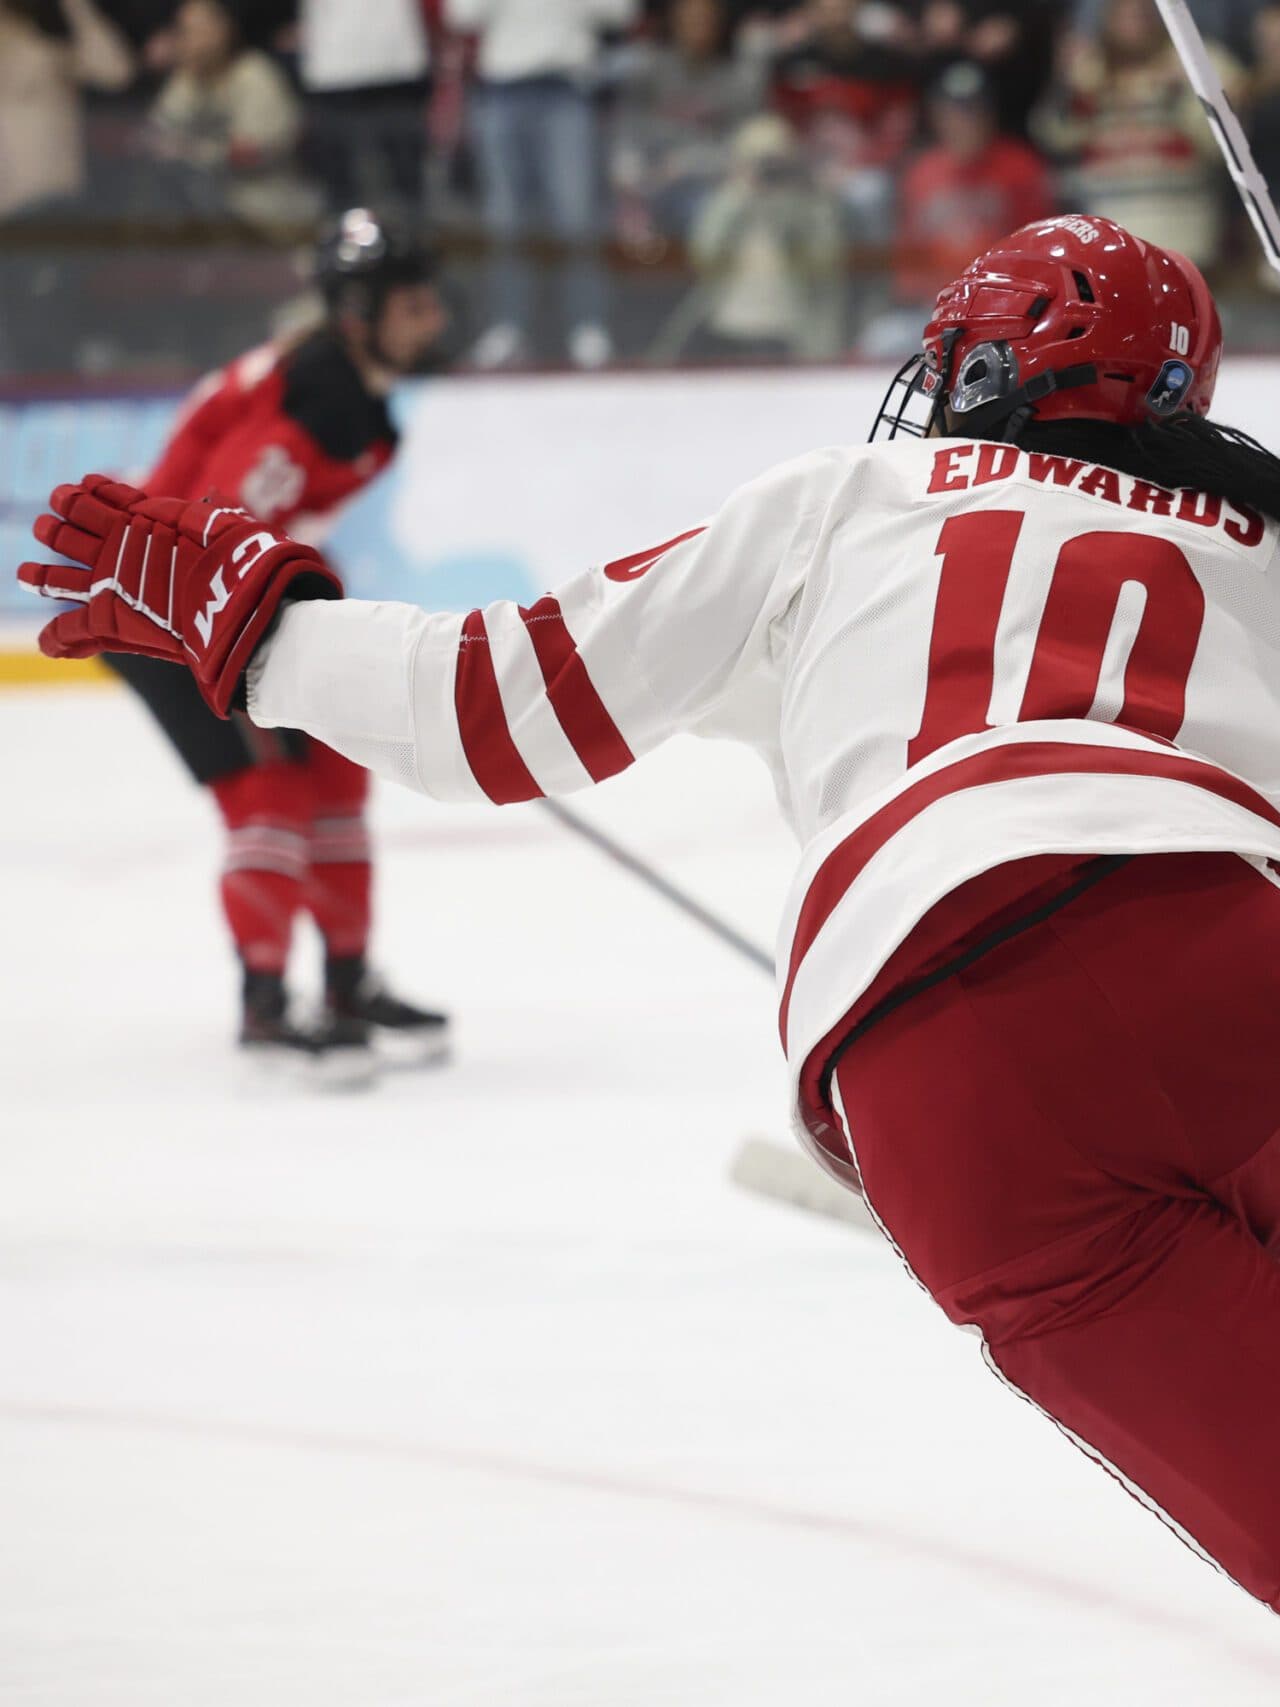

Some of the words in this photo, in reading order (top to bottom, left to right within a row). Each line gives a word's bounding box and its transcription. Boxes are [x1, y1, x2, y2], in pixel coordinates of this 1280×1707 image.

[1169, 321, 1189, 356] 10
[926, 443, 1266, 548] EDWARDS
[193, 531, 290, 649] CM
[906, 509, 1205, 771] 10
